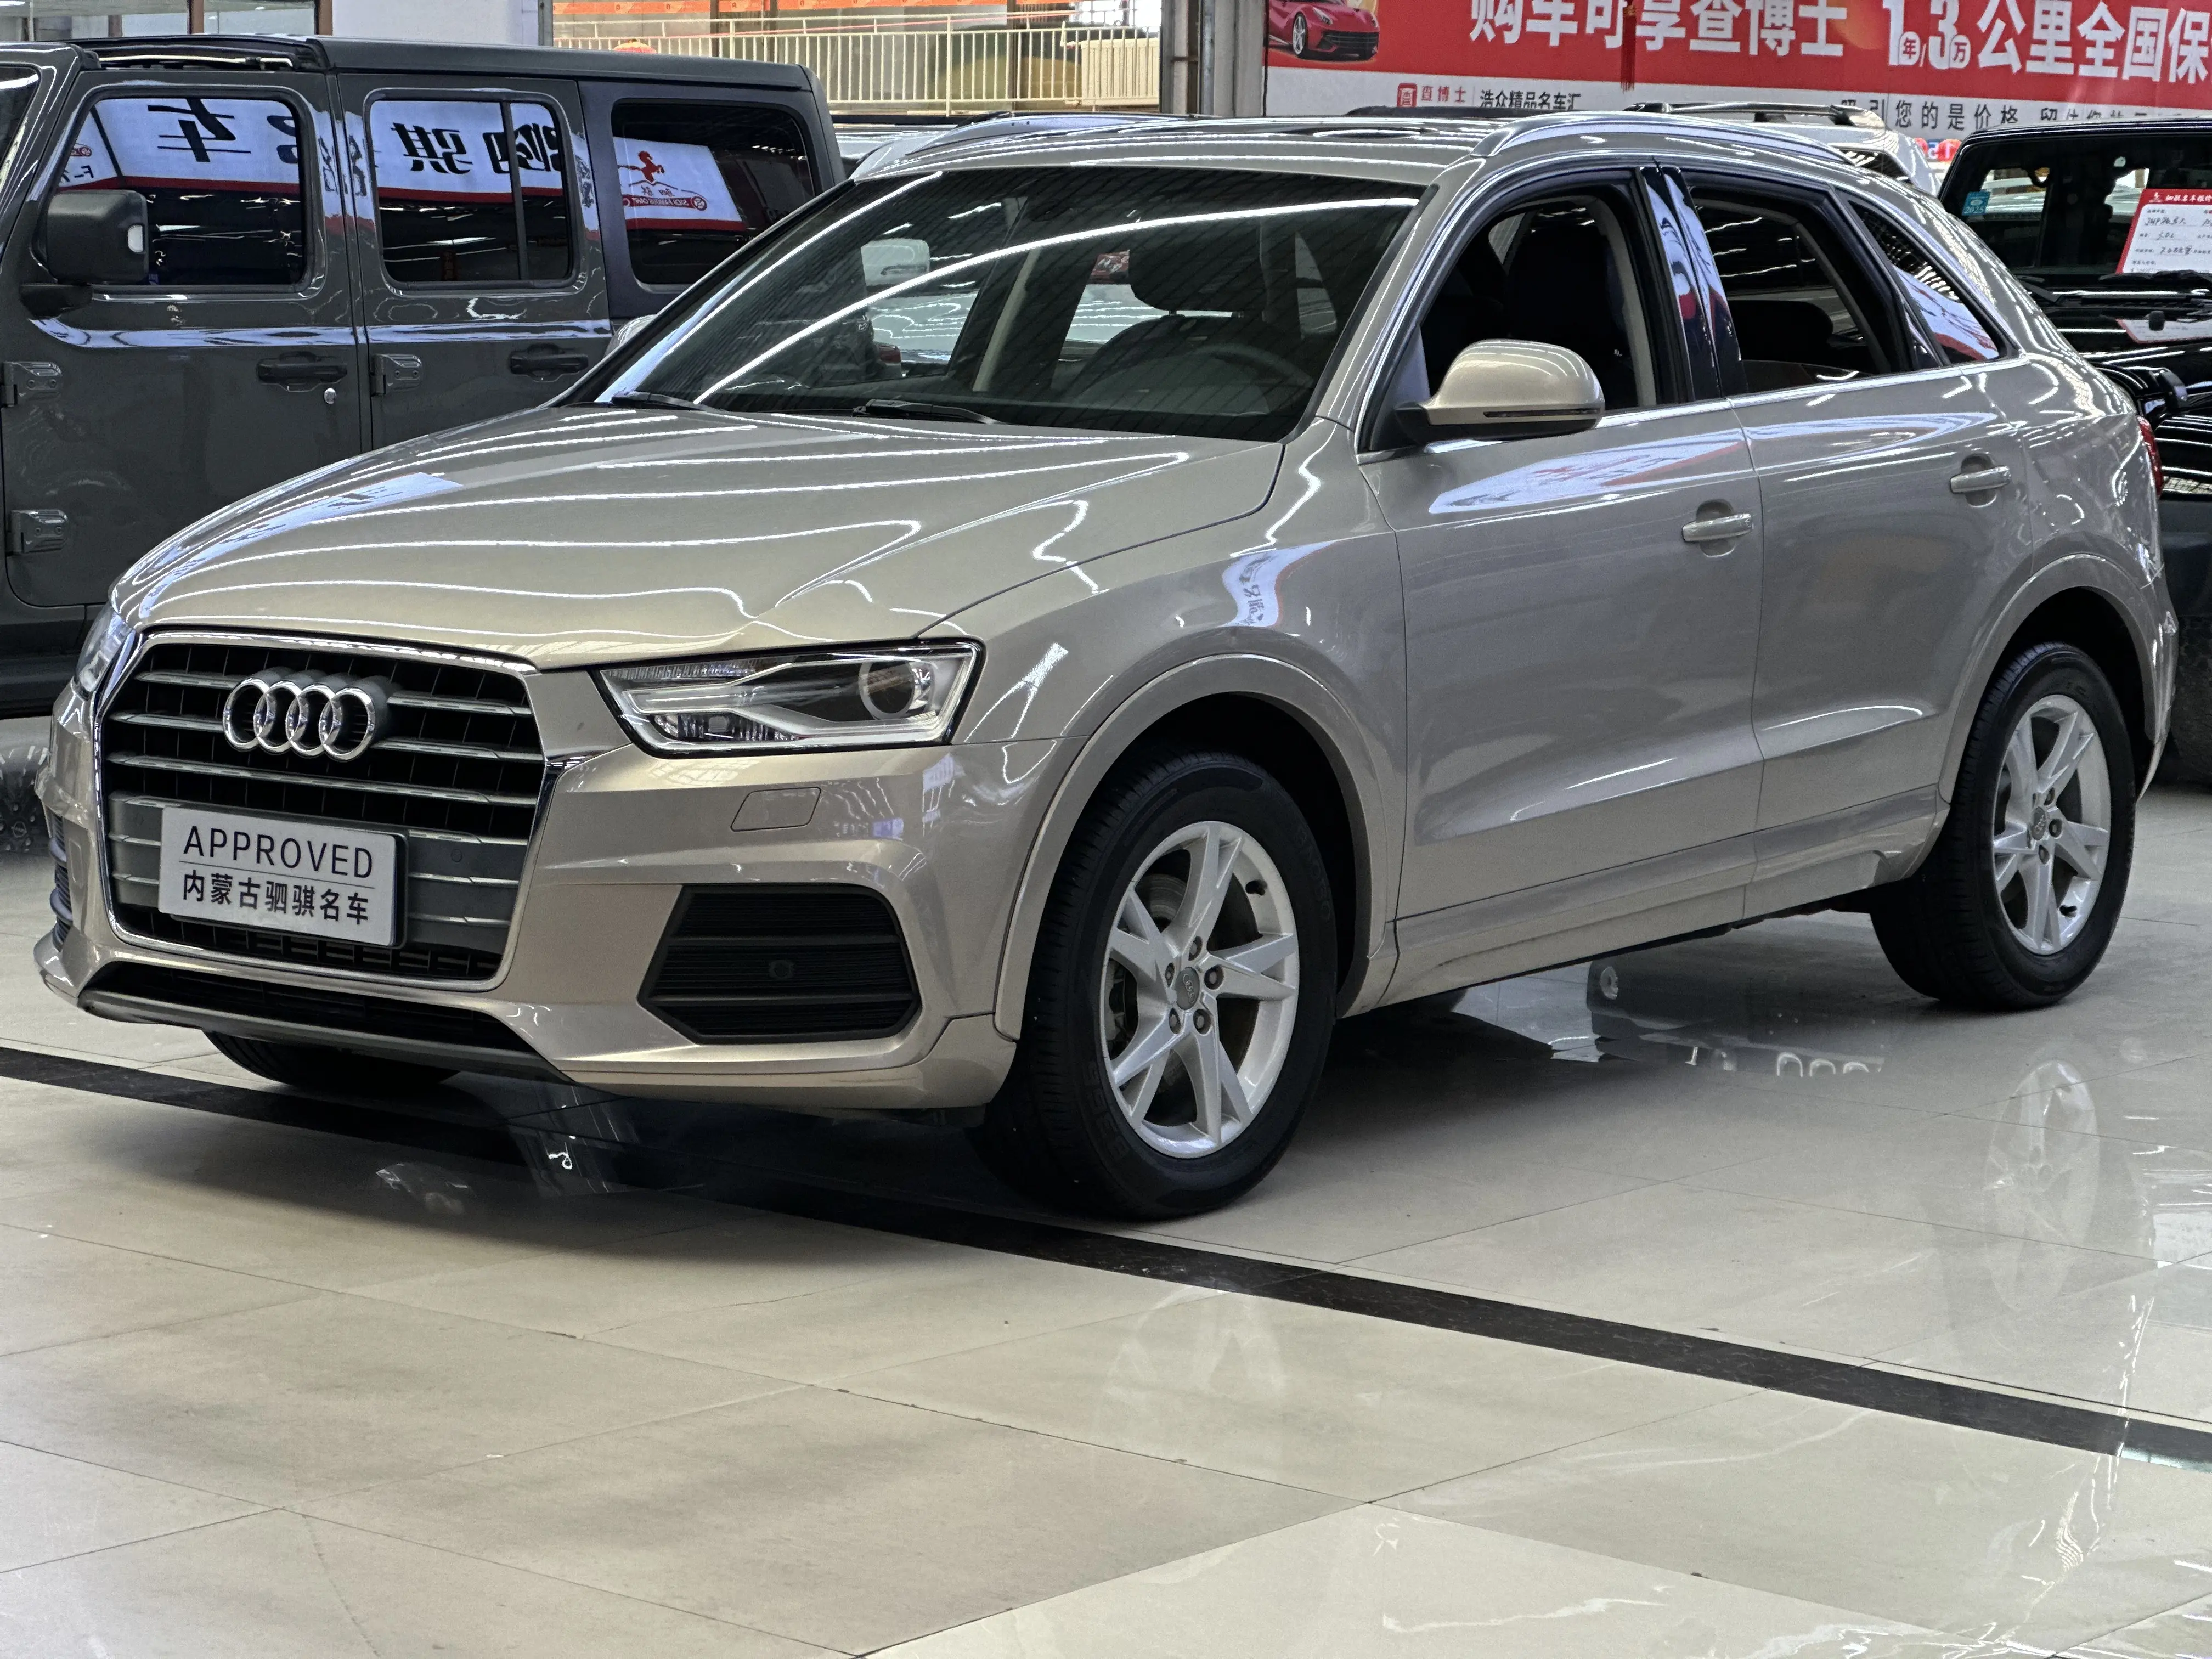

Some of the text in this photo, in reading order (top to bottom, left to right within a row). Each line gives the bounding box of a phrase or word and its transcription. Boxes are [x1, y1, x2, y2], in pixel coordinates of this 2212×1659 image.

[1470, 0, 2212, 84] 购车可享查博士 1年/3万公里全国保
[1420, 85, 1467, 103] 查博士
[183, 825, 372, 878] APPROVED
[183, 870, 369, 925] 内蒙古驷骐名车
